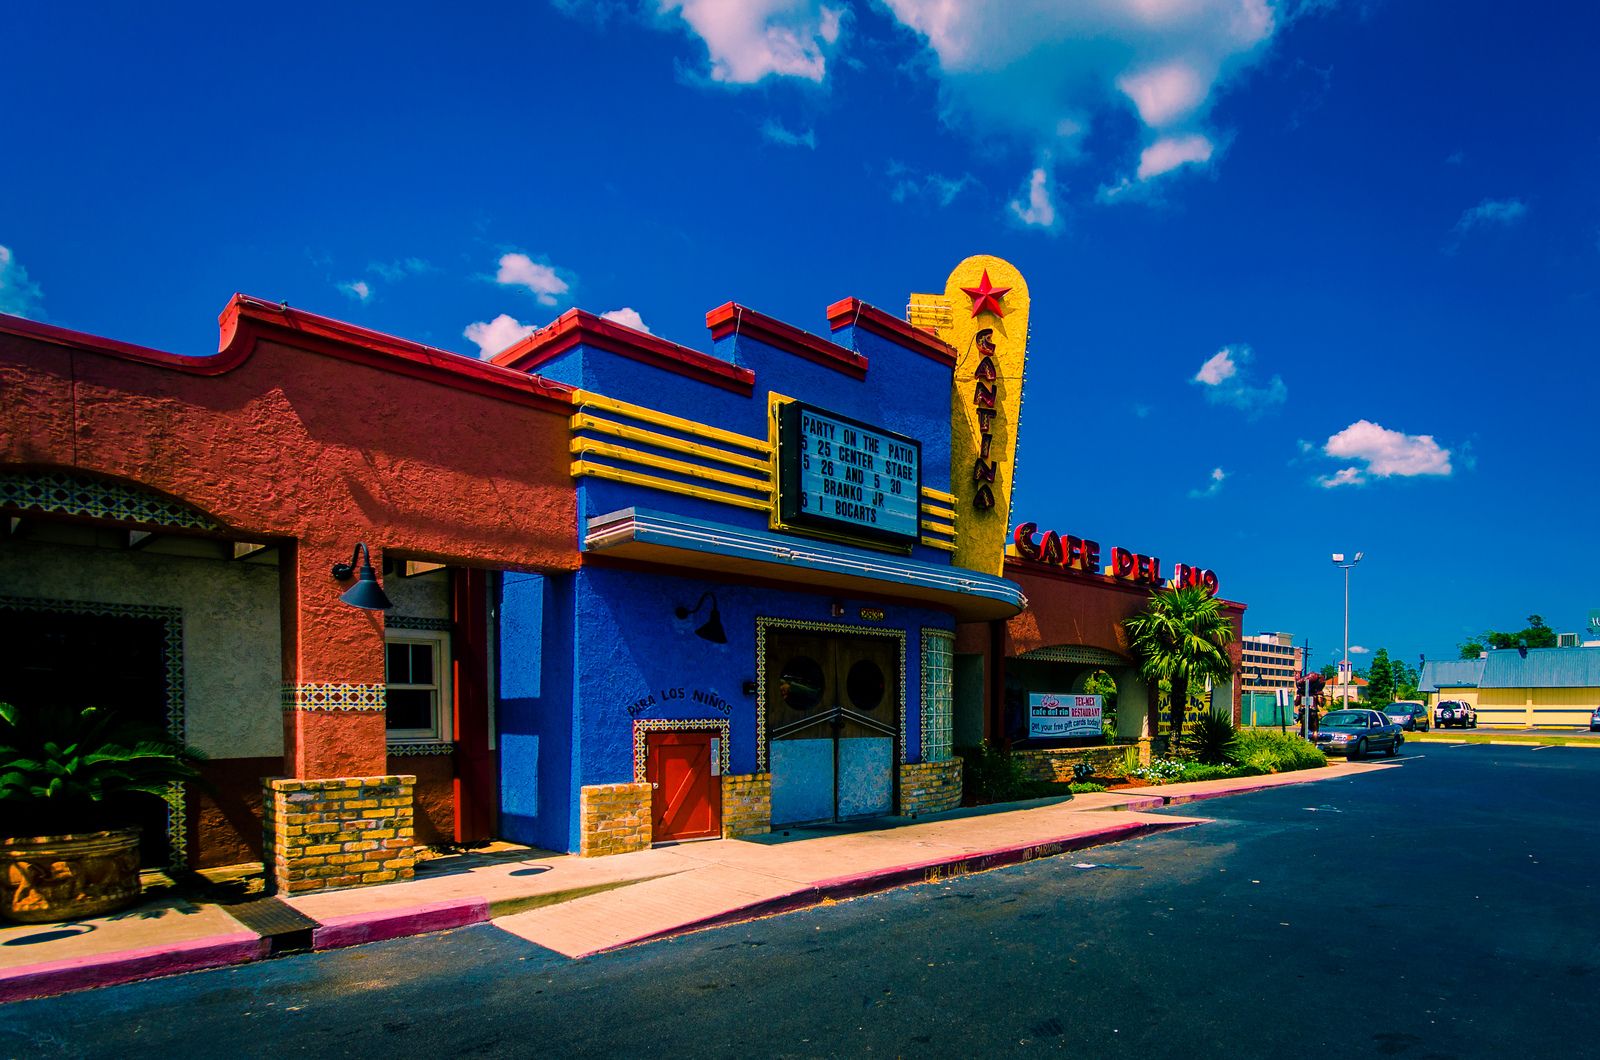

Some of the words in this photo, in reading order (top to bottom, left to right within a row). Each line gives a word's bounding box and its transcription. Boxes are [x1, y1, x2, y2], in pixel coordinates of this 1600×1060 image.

[973, 328, 997, 511] CANTINA
[803, 415, 835, 440] PARTY
[843, 429, 857, 447] ON
[863, 435, 880, 454] THE
[888, 443, 914, 465] PATIO
[801, 434, 808, 451] 5
[817, 440, 831, 457] 25
[838, 445, 874, 470] CENTER
[885, 460, 914, 481] STAGE
[803, 453, 810, 470] 5
[821, 459, 834, 476] 26
[845, 467, 864, 484] AND
[874, 474, 881, 489] 5
[890, 479, 902, 495] 30
[819, 495, 824, 512] 1
[823, 478, 863, 502] BRANKO
[872, 492, 885, 508] JR
[1014, 522, 1100, 574] CAFE
[1111, 546, 1166, 587] DEL
[1174, 563, 1219, 598] RIO
[627, 695, 656, 717] PARA
[661, 687, 685, 701] LOS
[693, 689, 733, 716] NIÑOS
[1071, 708, 1100, 717] RESTAURANT
[1075, 697, 1095, 706] TEX-MEX
[1031, 723, 1040, 731] get
[1053, 723, 1063, 731] free
[1064, 720, 1073, 730] gift
[1072, 719, 1086, 727] cards
[1022, 847, 1033, 860] NO
[1034, 843, 1063, 857] PARKING
[924, 867, 943, 881] FIRE
[947, 861, 969, 877] LANE
